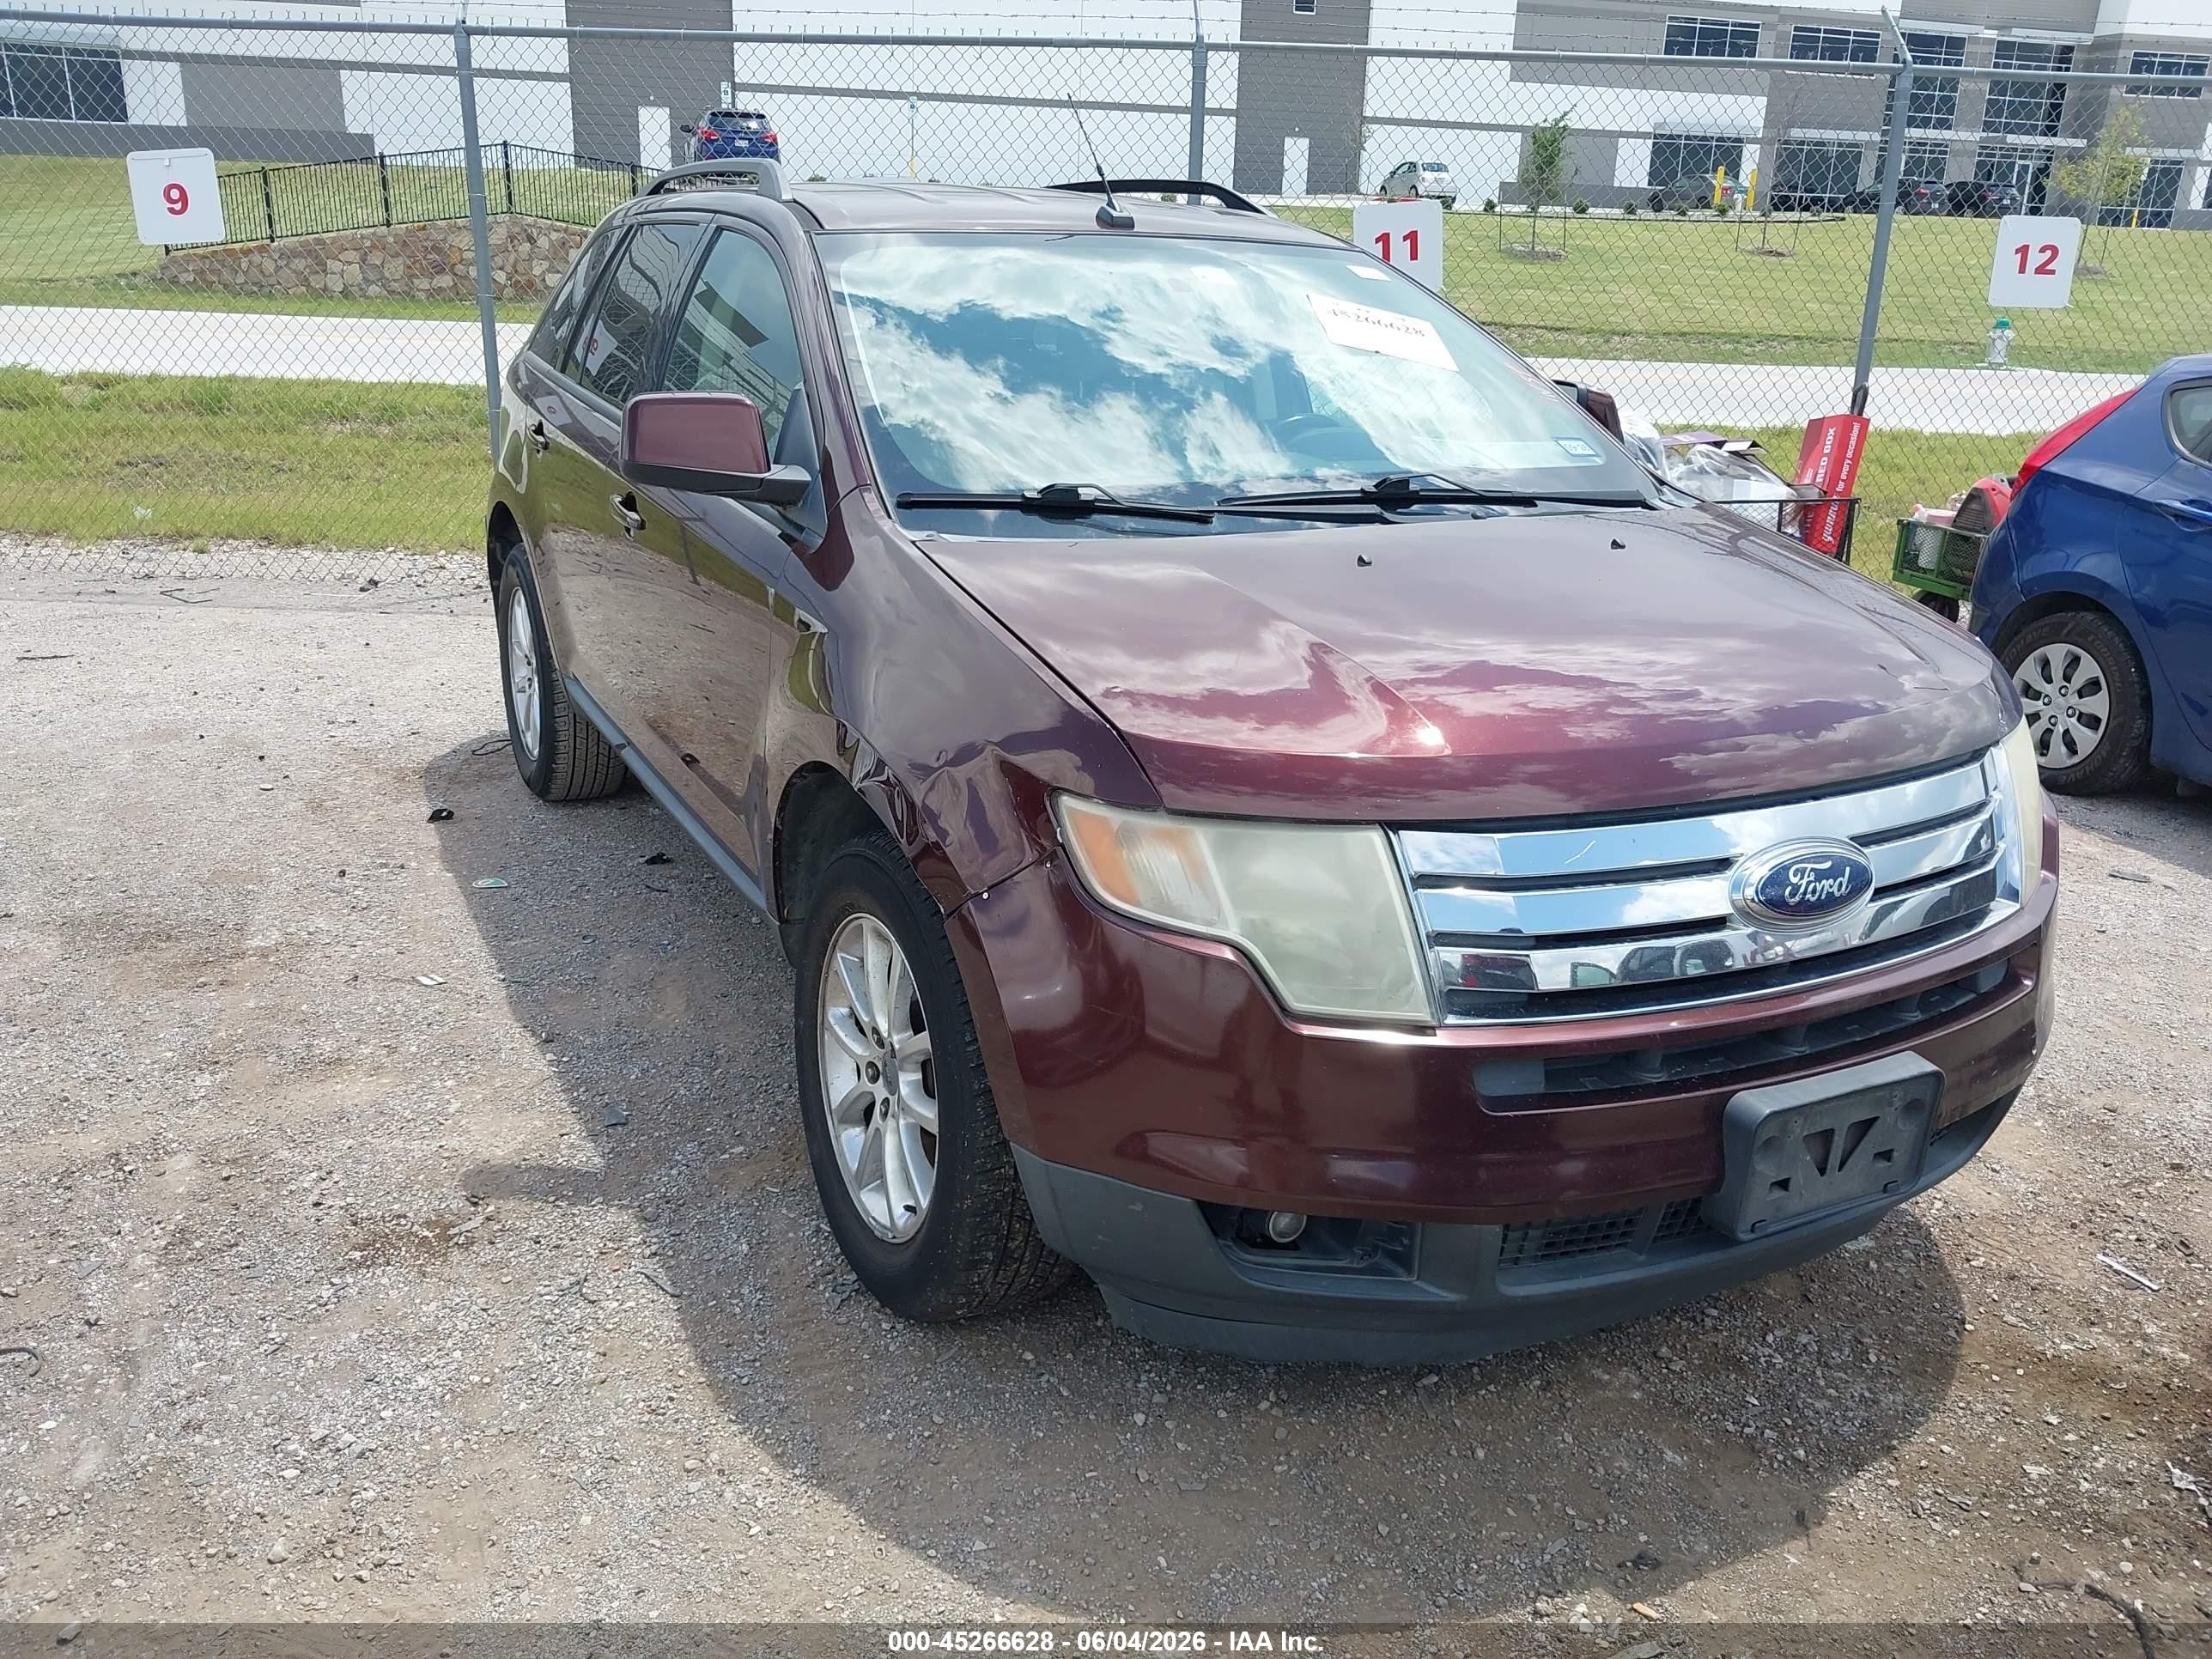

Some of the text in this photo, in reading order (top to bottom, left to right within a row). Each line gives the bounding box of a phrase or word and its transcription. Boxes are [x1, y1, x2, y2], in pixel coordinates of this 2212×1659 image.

[163, 183, 189, 216] 9
[1375, 230, 1419, 263] 11
[2014, 244, 2059, 275] 12
[1815, 457, 1828, 483] RED
[1823, 427, 1837, 454] BOX
[1835, 479, 1845, 492] for
[1784, 860, 1852, 906] Ford
